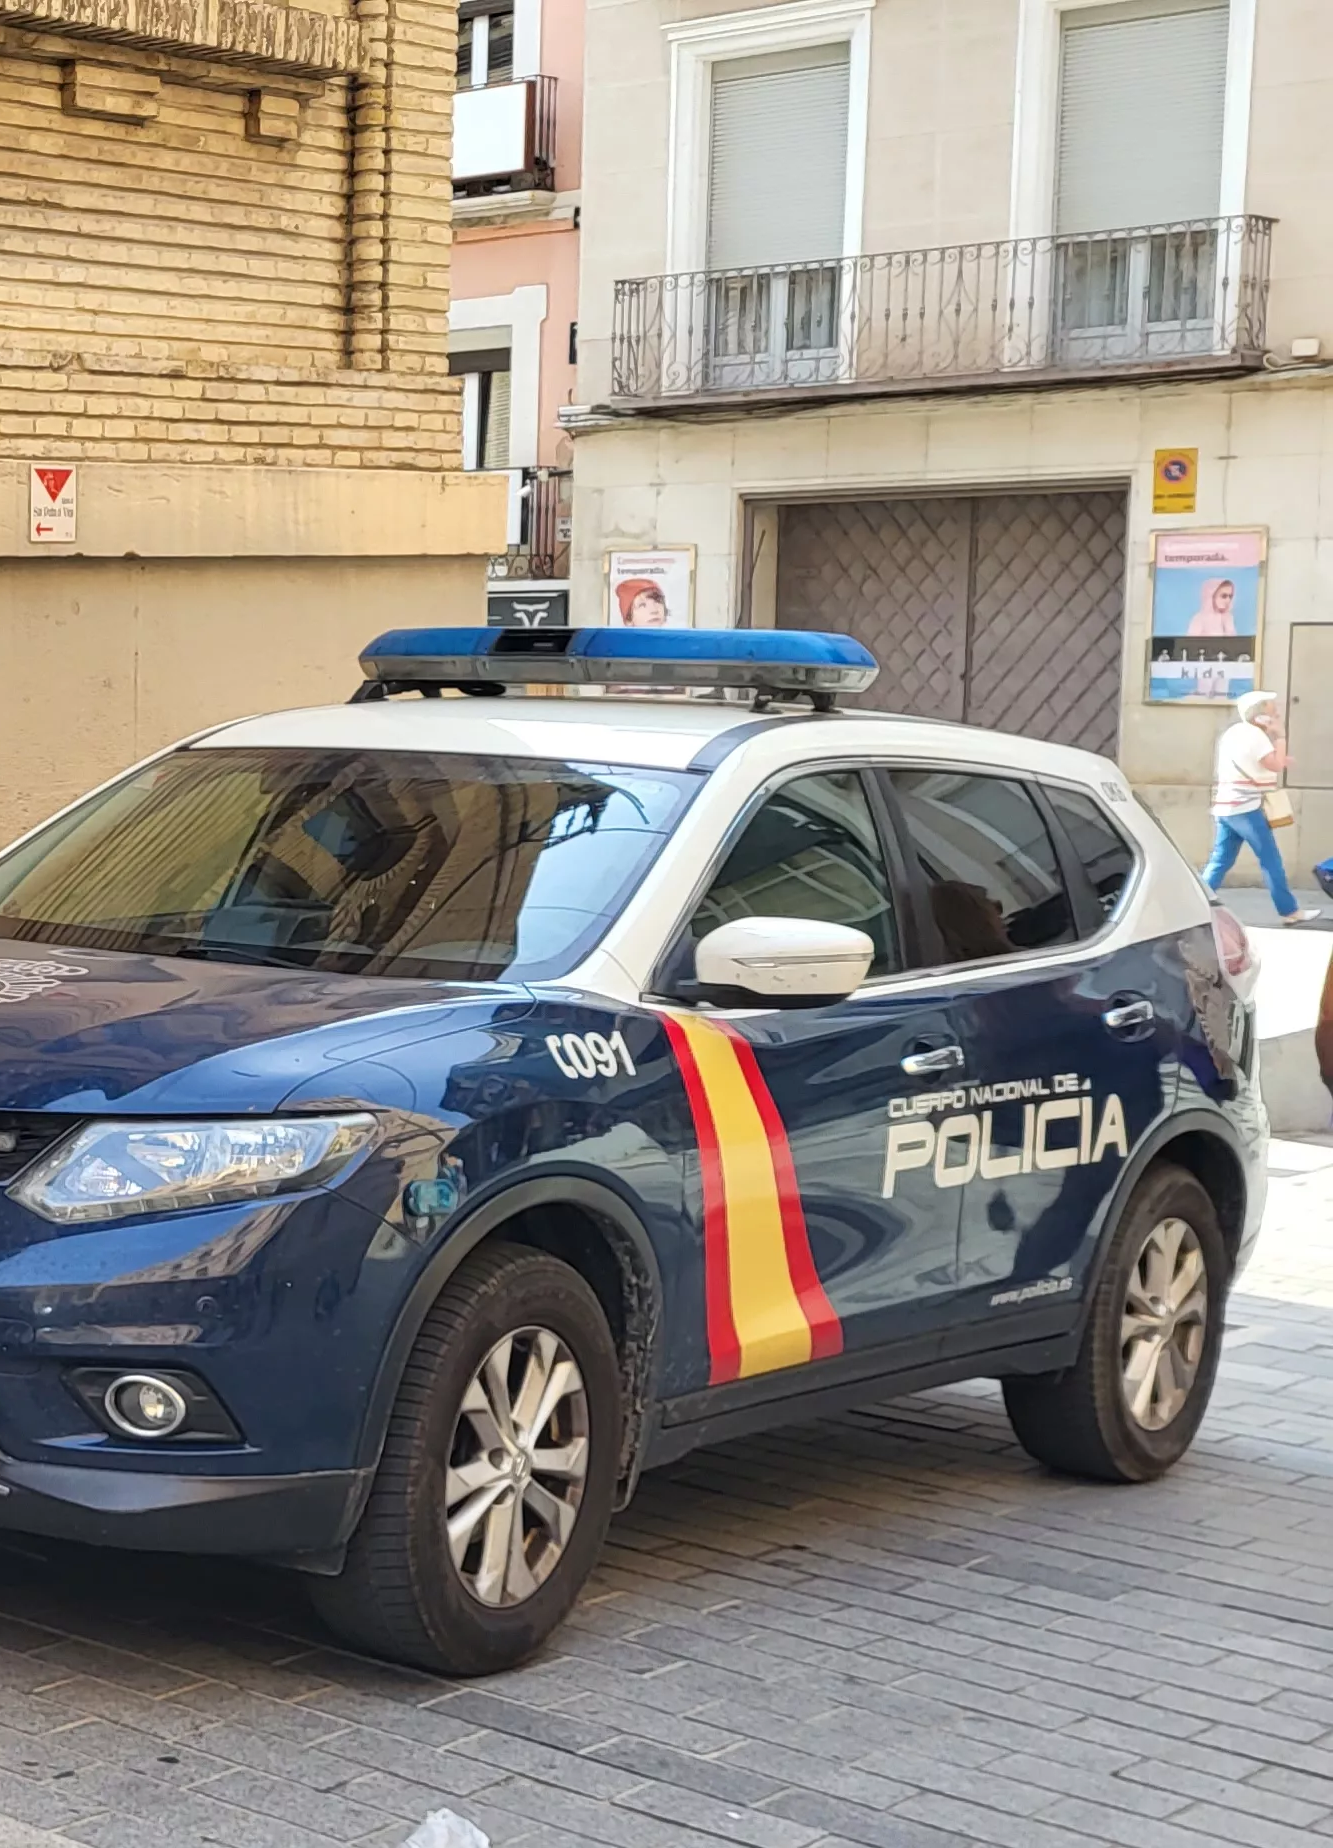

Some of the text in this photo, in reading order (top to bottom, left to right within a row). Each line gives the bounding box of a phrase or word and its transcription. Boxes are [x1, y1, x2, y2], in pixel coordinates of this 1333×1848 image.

[888, 1073, 1078, 1118] CUERPO NACIONAL DE
